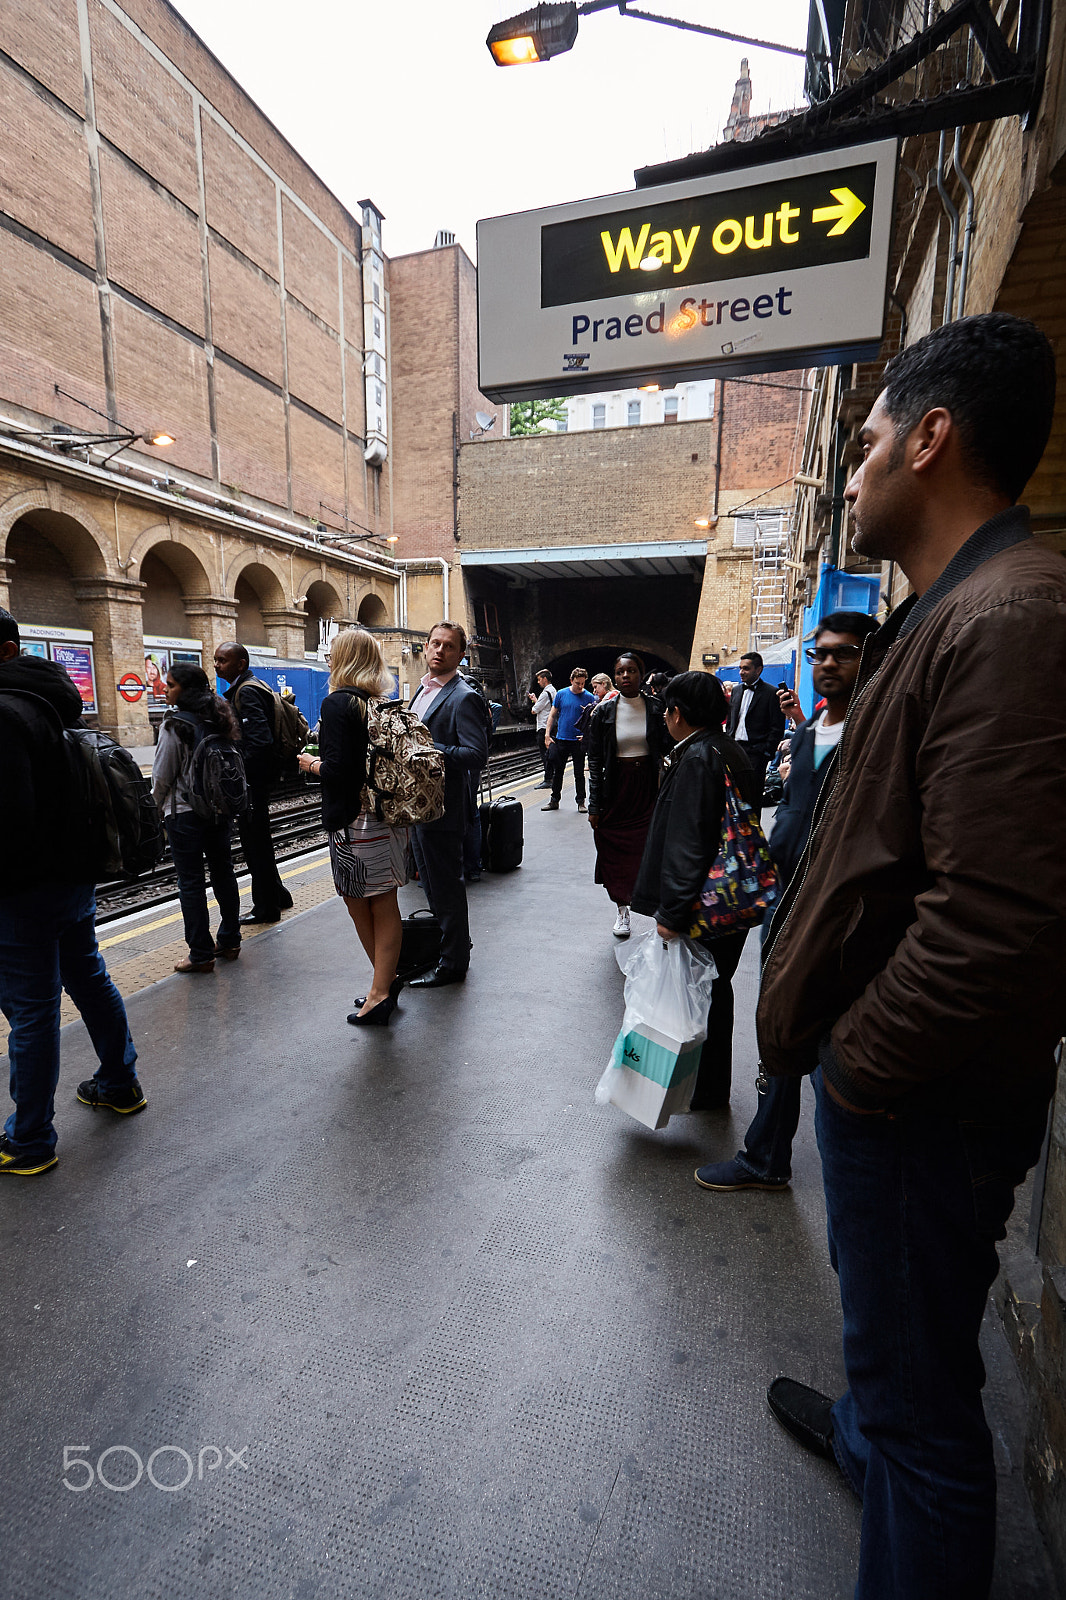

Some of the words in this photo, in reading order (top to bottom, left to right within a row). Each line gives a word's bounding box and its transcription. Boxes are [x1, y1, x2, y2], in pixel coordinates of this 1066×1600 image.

[600, 223, 700, 273] Way
[712, 202, 800, 254] out
[572, 303, 666, 345] Praed
[679, 287, 793, 331] Street
[30, 628, 65, 637] PADDINGTON
